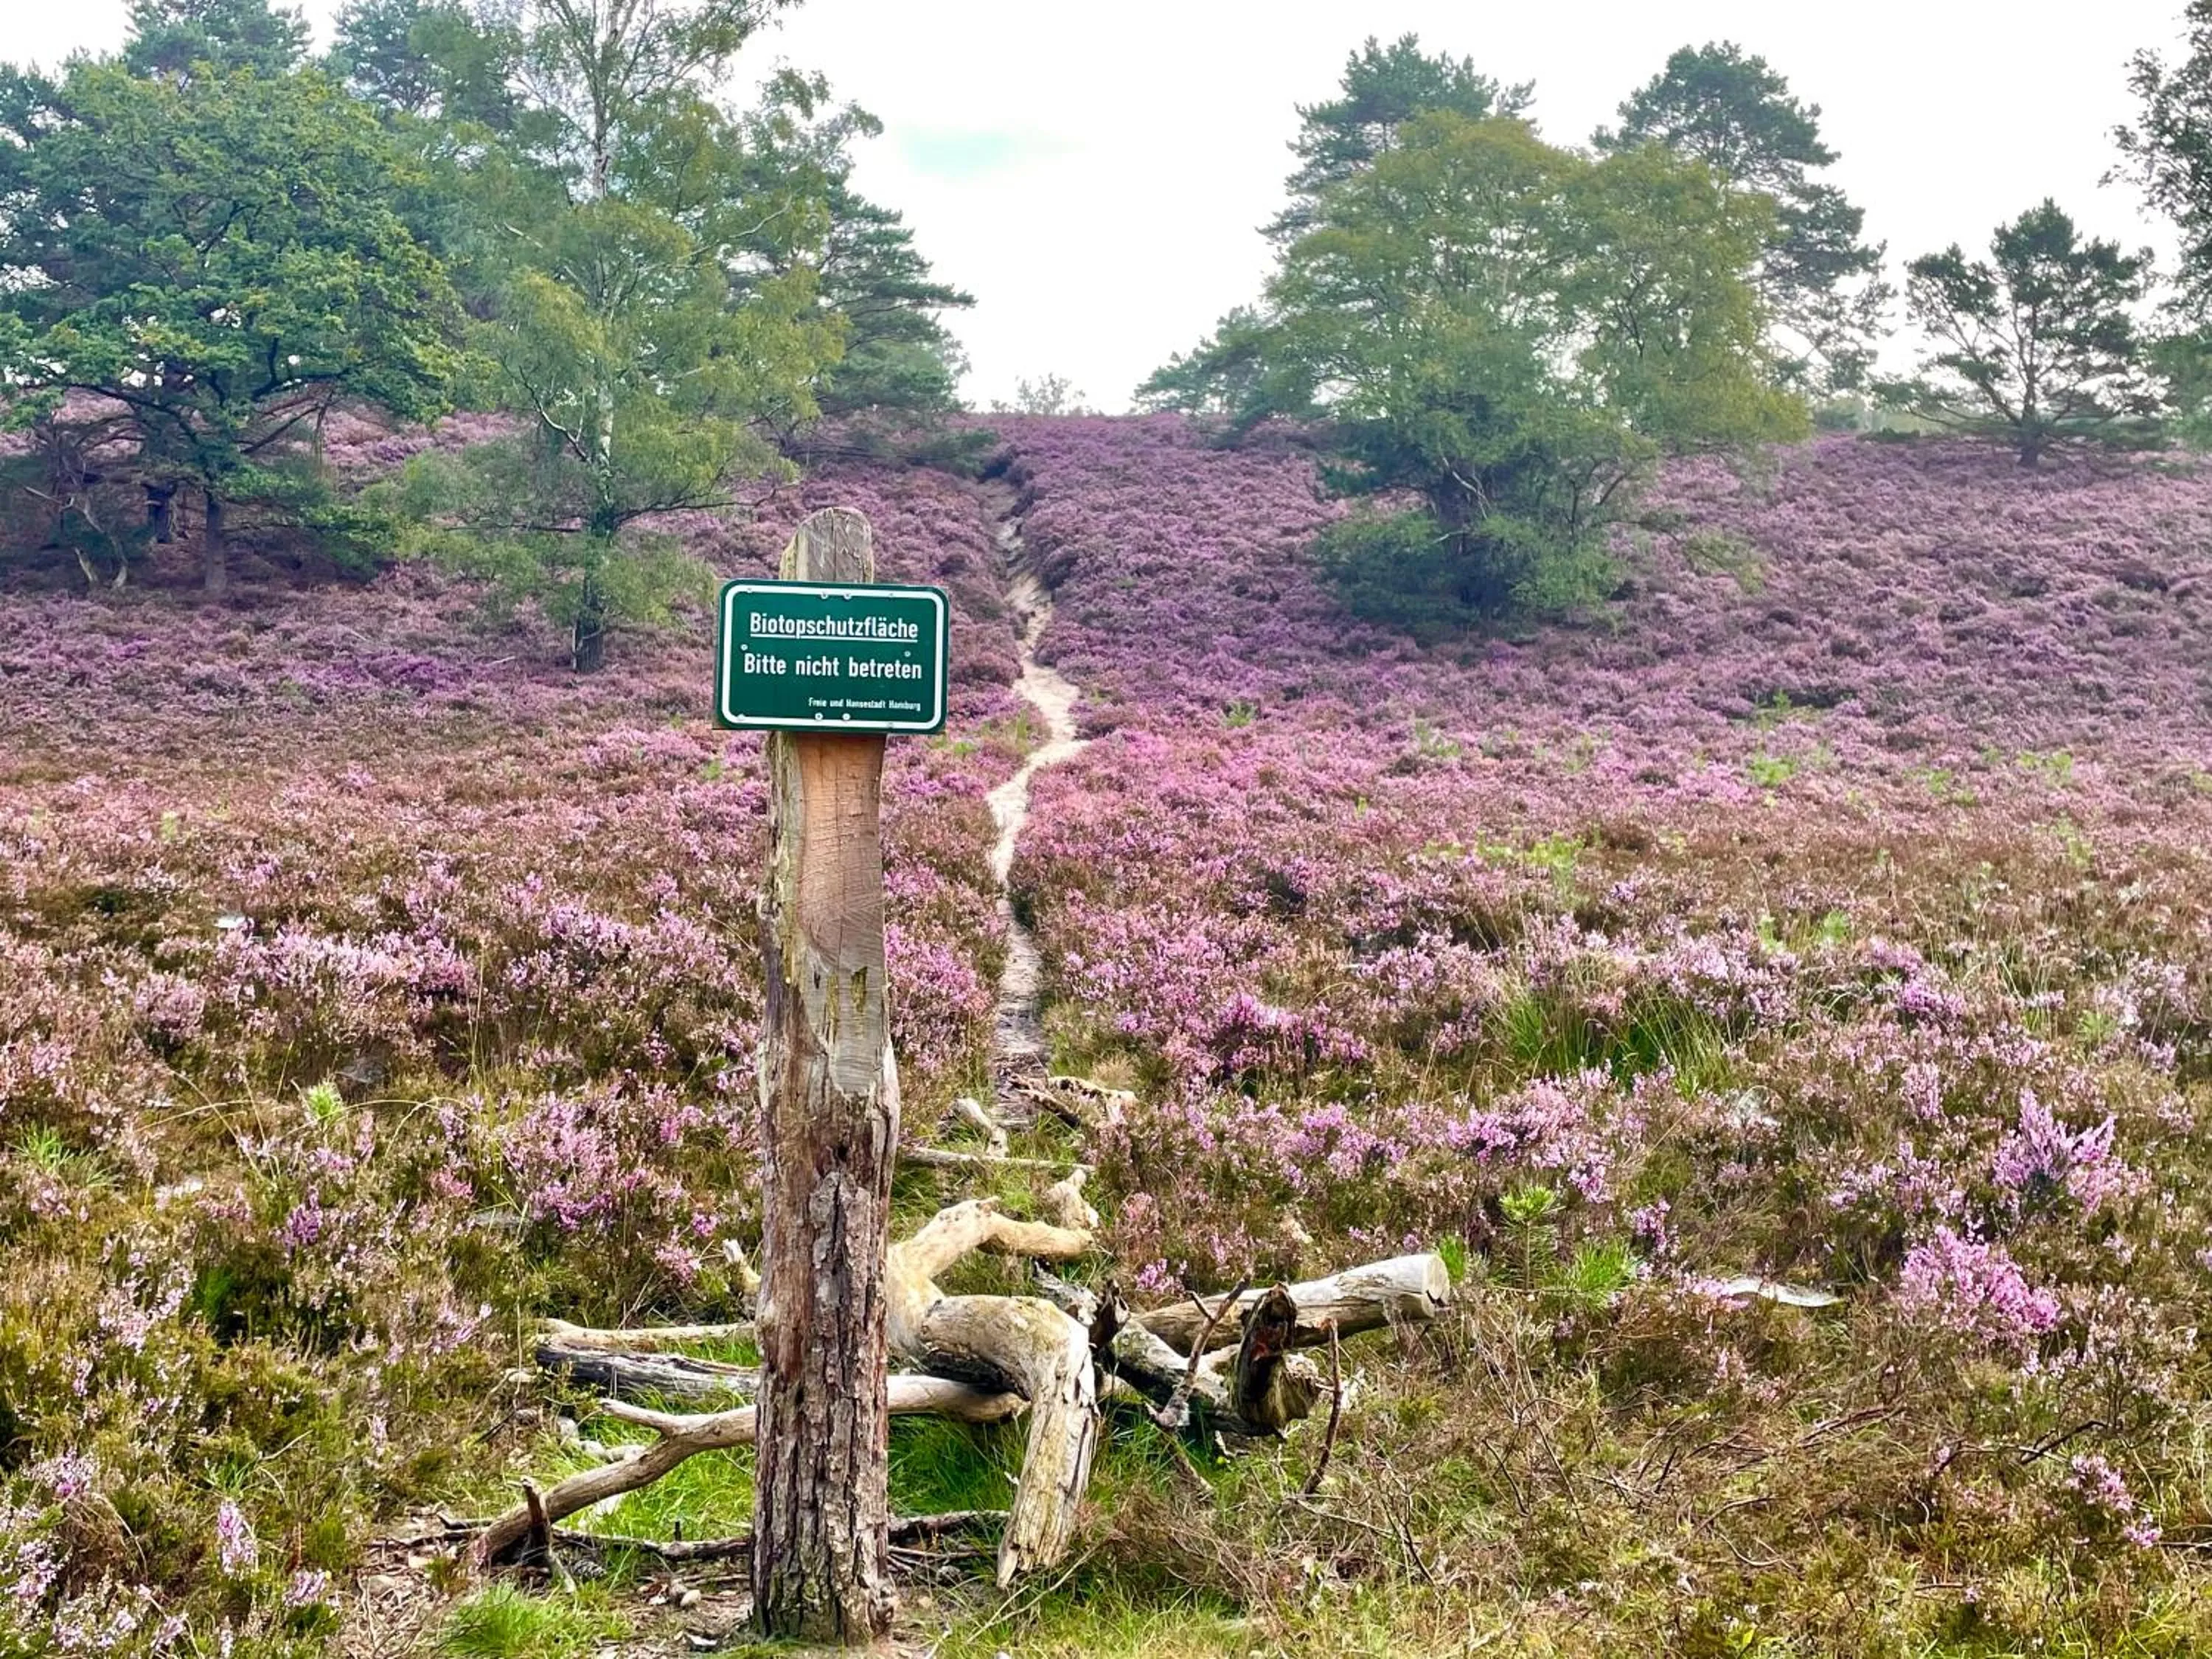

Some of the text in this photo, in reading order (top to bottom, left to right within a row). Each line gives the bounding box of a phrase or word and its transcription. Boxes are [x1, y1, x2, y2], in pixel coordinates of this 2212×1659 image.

[750, 612, 918, 639] Biotopschutzfläche
[744, 653, 922, 679] Bitte nicht betreten
[808, 697, 921, 712] Freie und Hansestadt Hamburg
